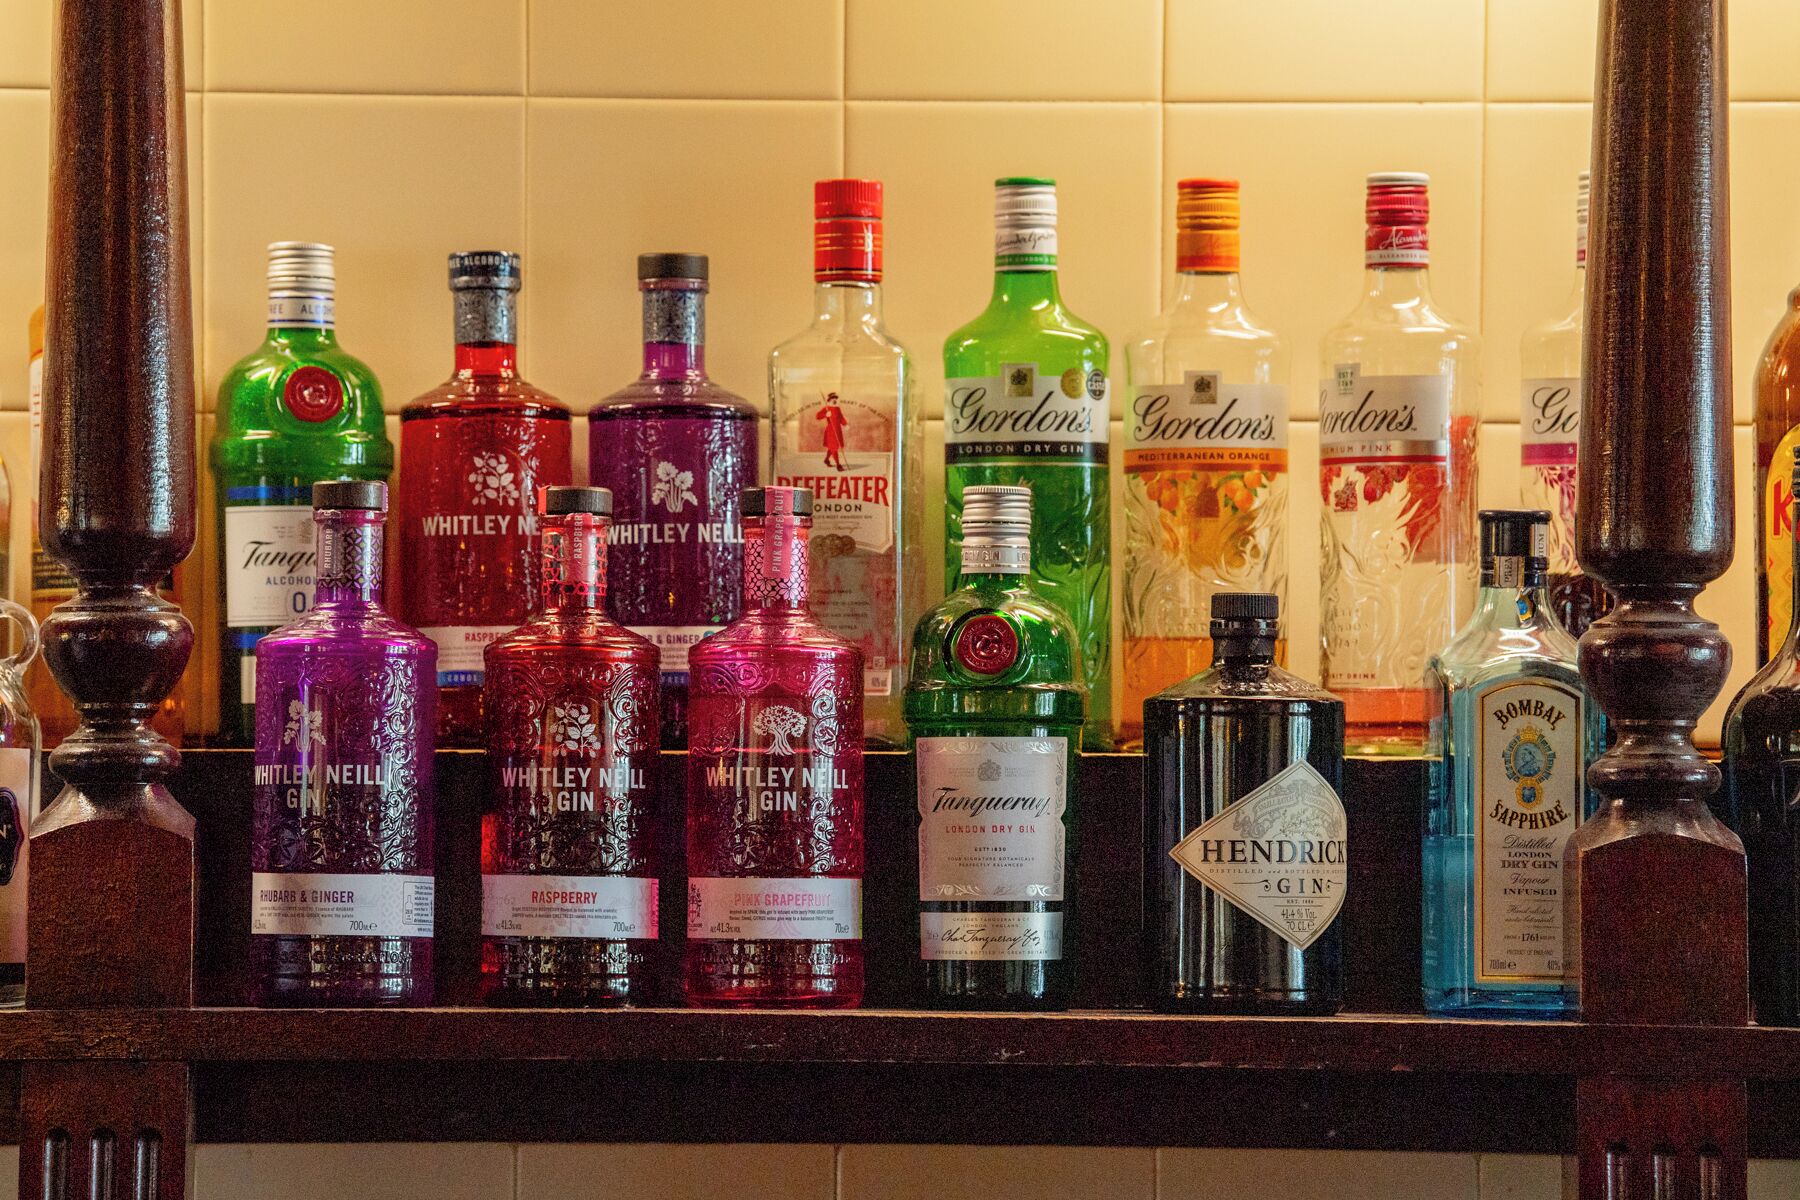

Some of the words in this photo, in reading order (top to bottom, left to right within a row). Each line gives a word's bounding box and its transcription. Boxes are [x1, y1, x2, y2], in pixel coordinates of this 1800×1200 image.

[952, 387, 1092, 434] Gordon's
[1133, 395, 1275, 441] Gordon's
[1320, 390, 1416, 433] ordon's
[958, 444, 1014, 454] LONDON
[1023, 444, 1051, 453] DRY
[1060, 444, 1085, 453] GIN
[1138, 452, 1225, 462] MEDITERRANEAN
[1228, 451, 1271, 461] ORANGE
[1361, 444, 1392, 453] PINK
[813, 504, 863, 514] ONDON
[422, 515, 511, 537] WHITLEY
[573, 512, 583, 559] RASPBERR
[606, 524, 692, 544] WHITLEY
[243, 540, 316, 574] Tanqu
[323, 528, 333, 569] RHUBARB
[772, 551, 781, 572] PINK
[464, 632, 503, 642] RASPBE
[666, 634, 700, 644] GINGER
[1345, 672, 1375, 680] DRINK
[1493, 699, 1567, 731] BOMBAY
[254, 764, 318, 786] WHITLEY
[326, 764, 386, 785] NEILL
[502, 767, 591, 788] WHITLEY
[600, 768, 646, 789] NEILL
[706, 766, 795, 788] WHITLEY
[802, 768, 849, 789] NEILL
[286, 788, 321, 809] GIN
[557, 791, 594, 812] GIN
[760, 790, 798, 812] GIN
[1489, 799, 1568, 830] SAPPHIRE
[945, 825, 986, 834] LONDON
[992, 825, 1013, 833] DRY
[1019, 825, 1036, 833] GIN
[1201, 839, 1345, 864] HENDRICK
[1502, 834, 1557, 849] Distilled
[1500, 860, 1529, 869] DRY
[1531, 860, 1559, 869] GIN
[1277, 878, 1324, 894] GIN
[1509, 873, 1550, 888] Vapour
[260, 889, 296, 903] RHUBARB
[300, 890, 308, 903] &
[312, 890, 354, 904] GINGER
[531, 890, 598, 905] RASPBERRY
[734, 893, 762, 906] PINK
[765, 893, 831, 906] GRAPEFRUIT
[1503, 888, 1557, 896] INFUSED
[1521, 933, 1539, 942] 1761
